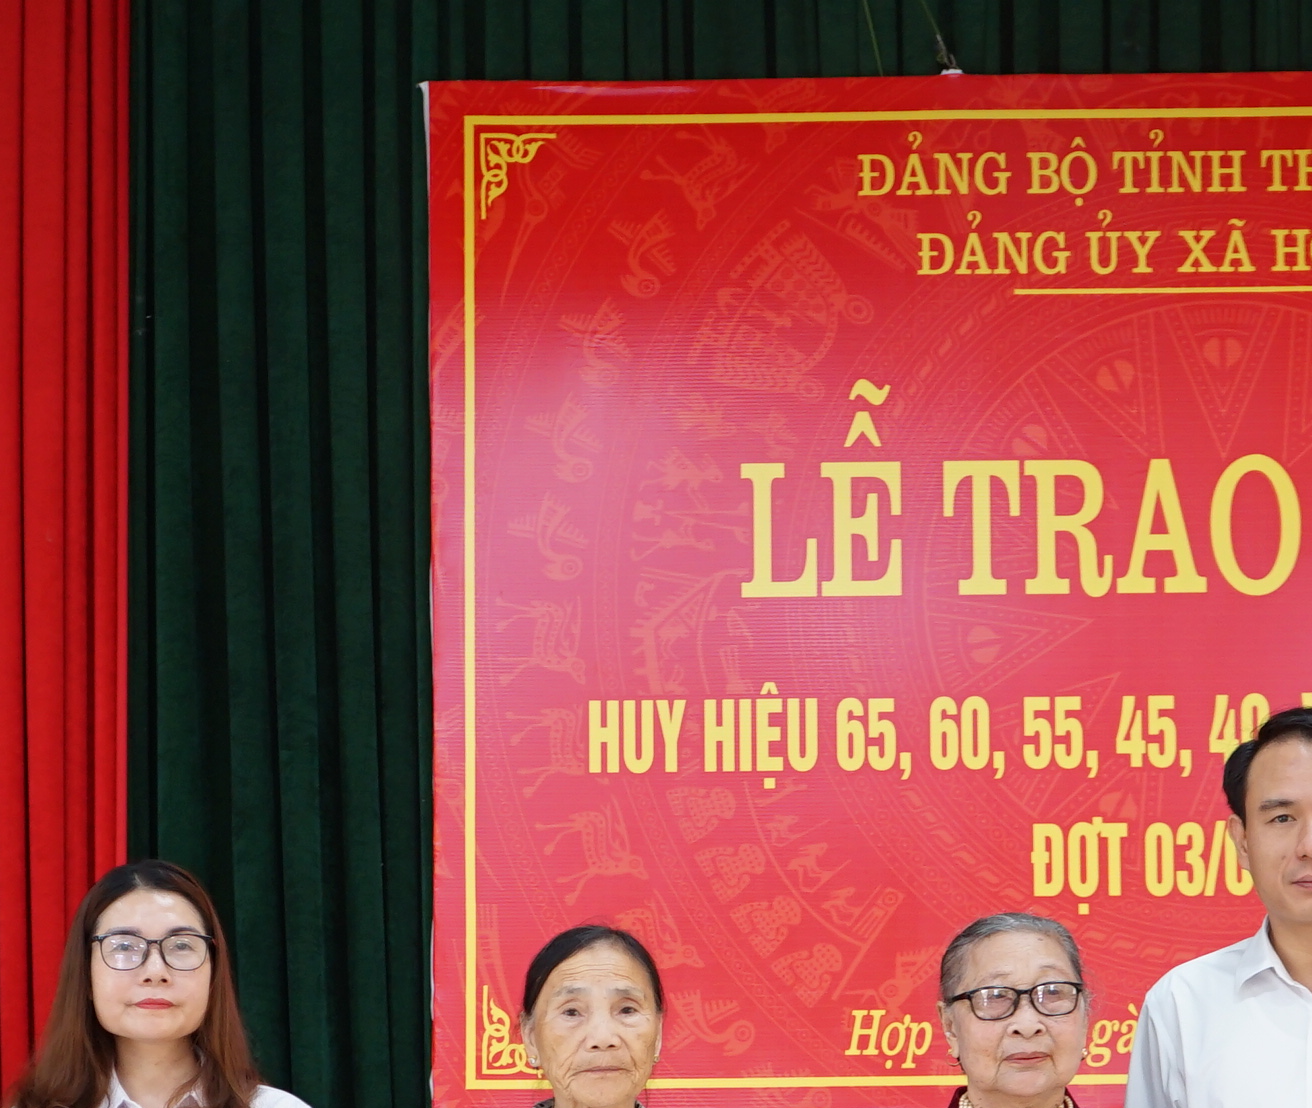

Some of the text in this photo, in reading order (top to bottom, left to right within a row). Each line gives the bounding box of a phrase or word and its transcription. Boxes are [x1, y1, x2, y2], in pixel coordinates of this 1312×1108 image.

[858, 130, 1011, 197] ĐẢNG
[1027, 136, 1097, 205] BỘ
[1112, 128, 1246, 194] TỈNH
[917, 210, 1070, 278] ĐẢNG
[1086, 208, 1160, 276] ỦY
[1177, 215, 1255, 274] XÃ
[741, 378, 903, 598] LỄ
[942, 453, 1301, 597] TRAO
[589, 699, 686, 774] HUY
[704, 682, 818, 789] HIỆU
[836, 697, 911, 780] 65,
[929, 695, 1005, 779] 60,
[1022, 696, 1098, 778] 55,
[1115, 695, 1191, 777] 45,
[1030, 816, 1128, 916] ĐỢT
[844, 1009, 934, 1070] Hợp
